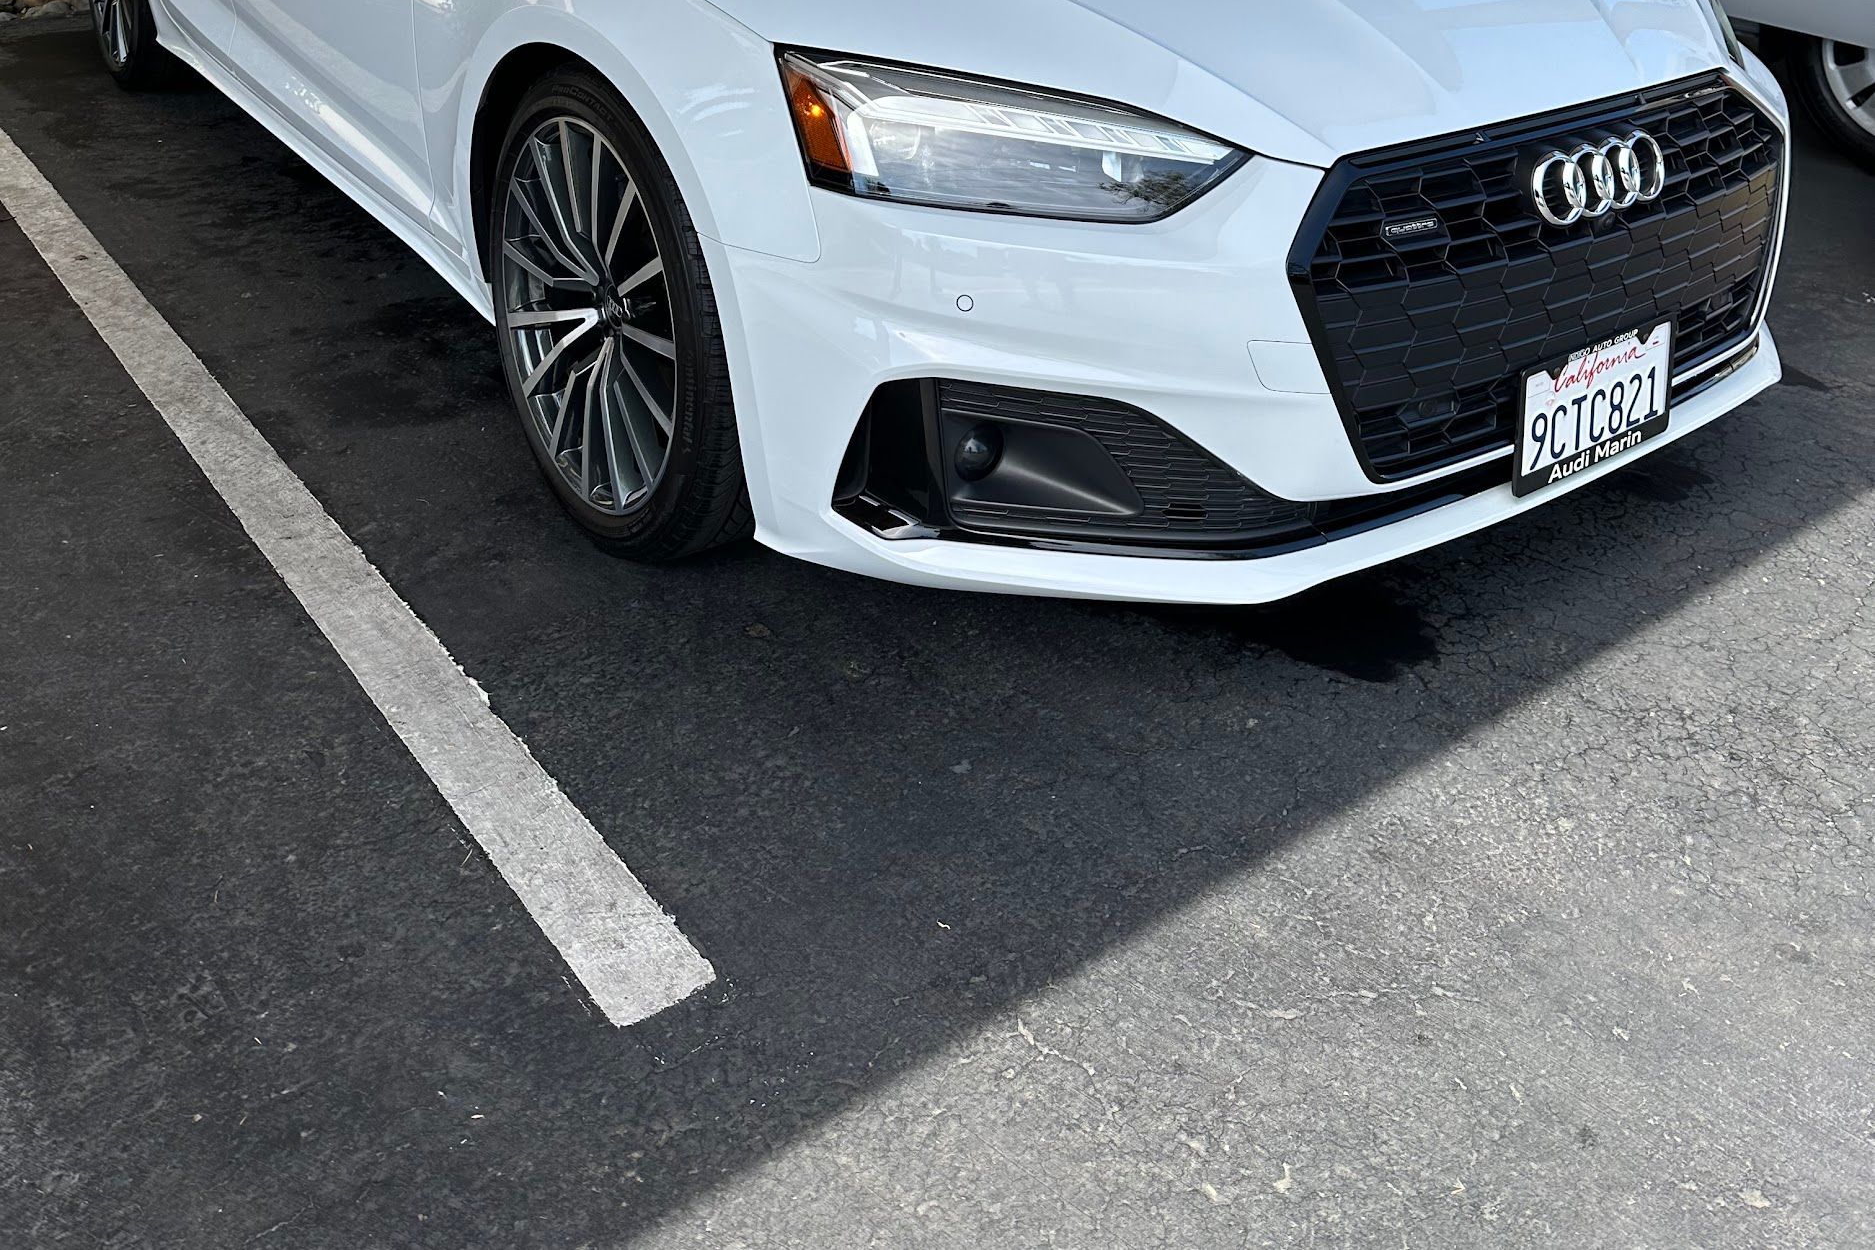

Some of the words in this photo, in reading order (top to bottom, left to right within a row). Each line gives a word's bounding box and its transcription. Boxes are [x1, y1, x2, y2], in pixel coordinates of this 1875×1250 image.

[1592, 339, 1612, 353] AUTO
[1614, 329, 1639, 344] GROUP
[1554, 345, 1646, 393] California
[1530, 366, 1658, 471] 9CTC821
[1548, 449, 1591, 484] Audi
[1594, 430, 1642, 463] Marin
